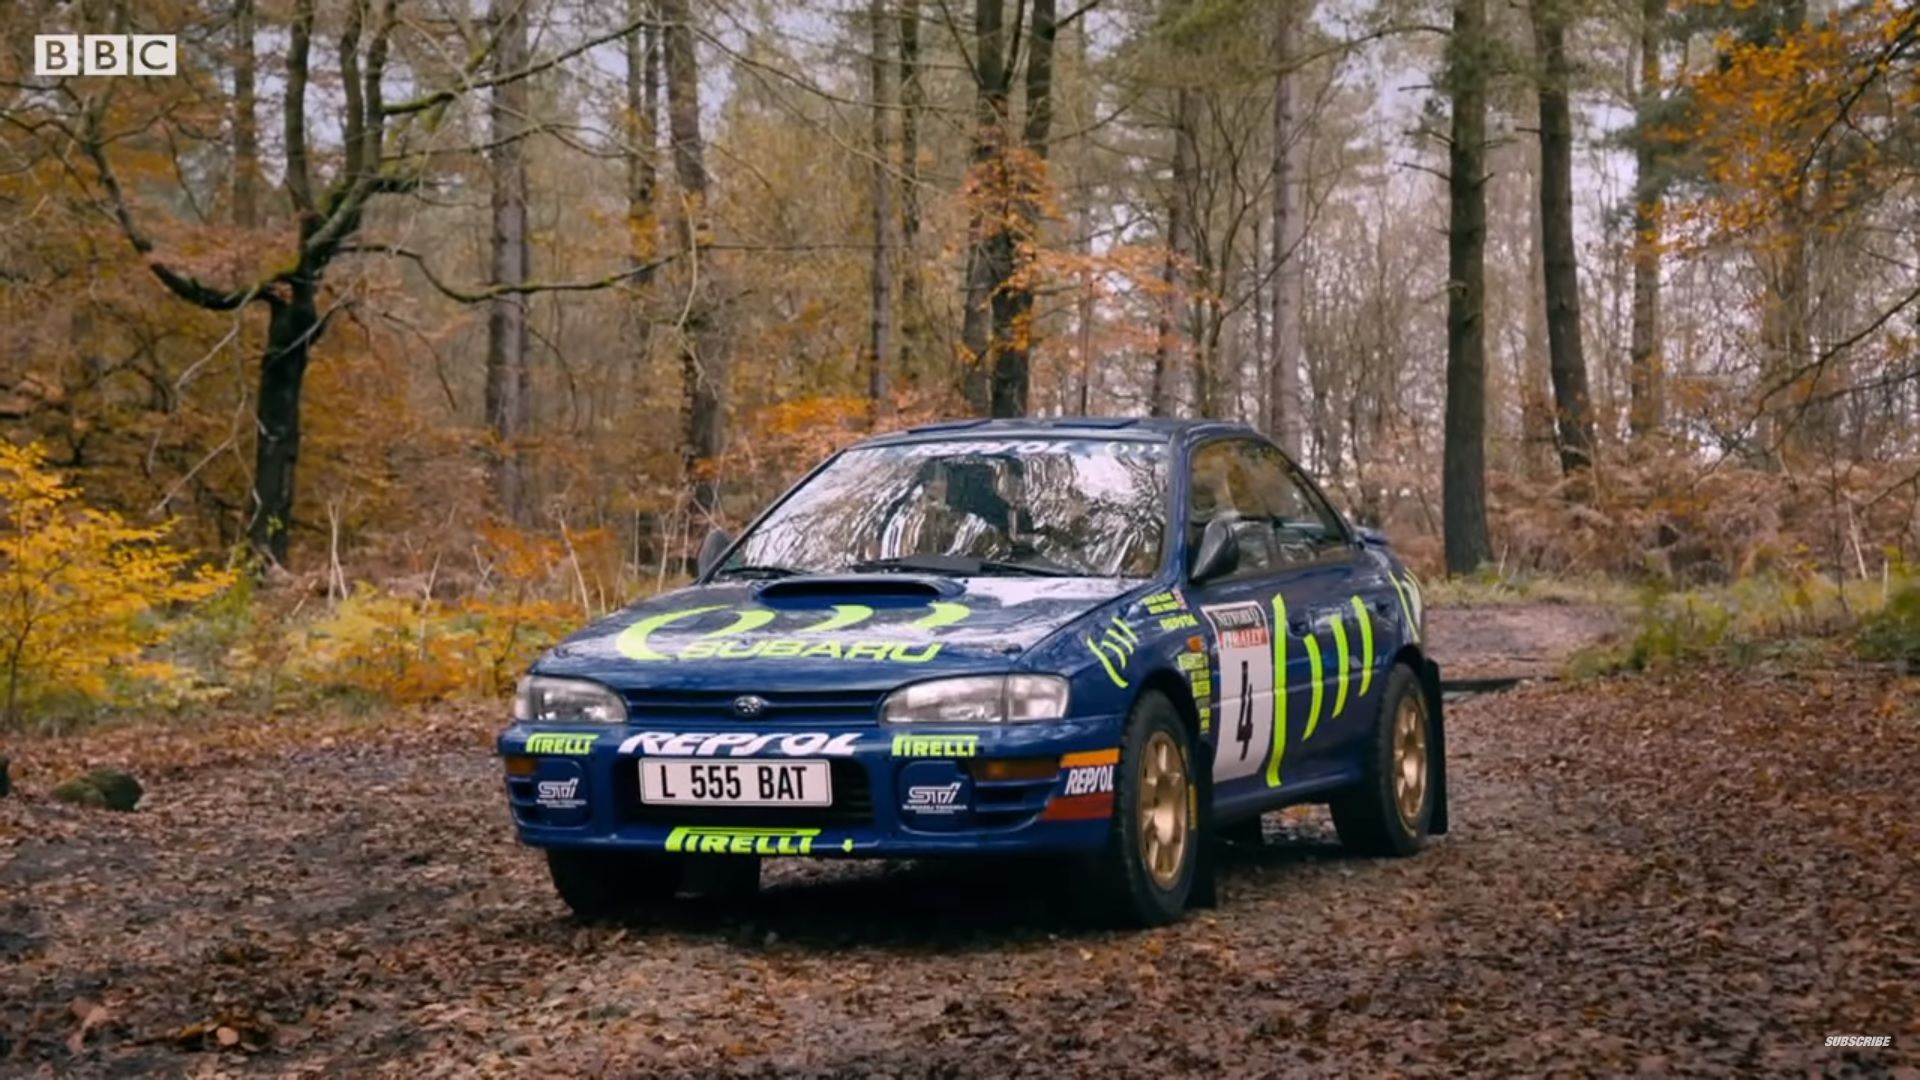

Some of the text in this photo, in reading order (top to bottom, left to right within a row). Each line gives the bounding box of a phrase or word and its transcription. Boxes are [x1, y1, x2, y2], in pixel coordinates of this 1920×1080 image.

[676, 640, 943, 663] SUBARU
[1236, 660, 1254, 762] 4
[526, 732, 600, 755] PIRELLI
[618, 731, 864, 756] REPSOL
[891, 734, 980, 757] PIRELLI
[660, 764, 808, 800] L 555 BAT
[1065, 765, 1114, 795] REPSOL
[665, 826, 822, 854] PIRELLI
